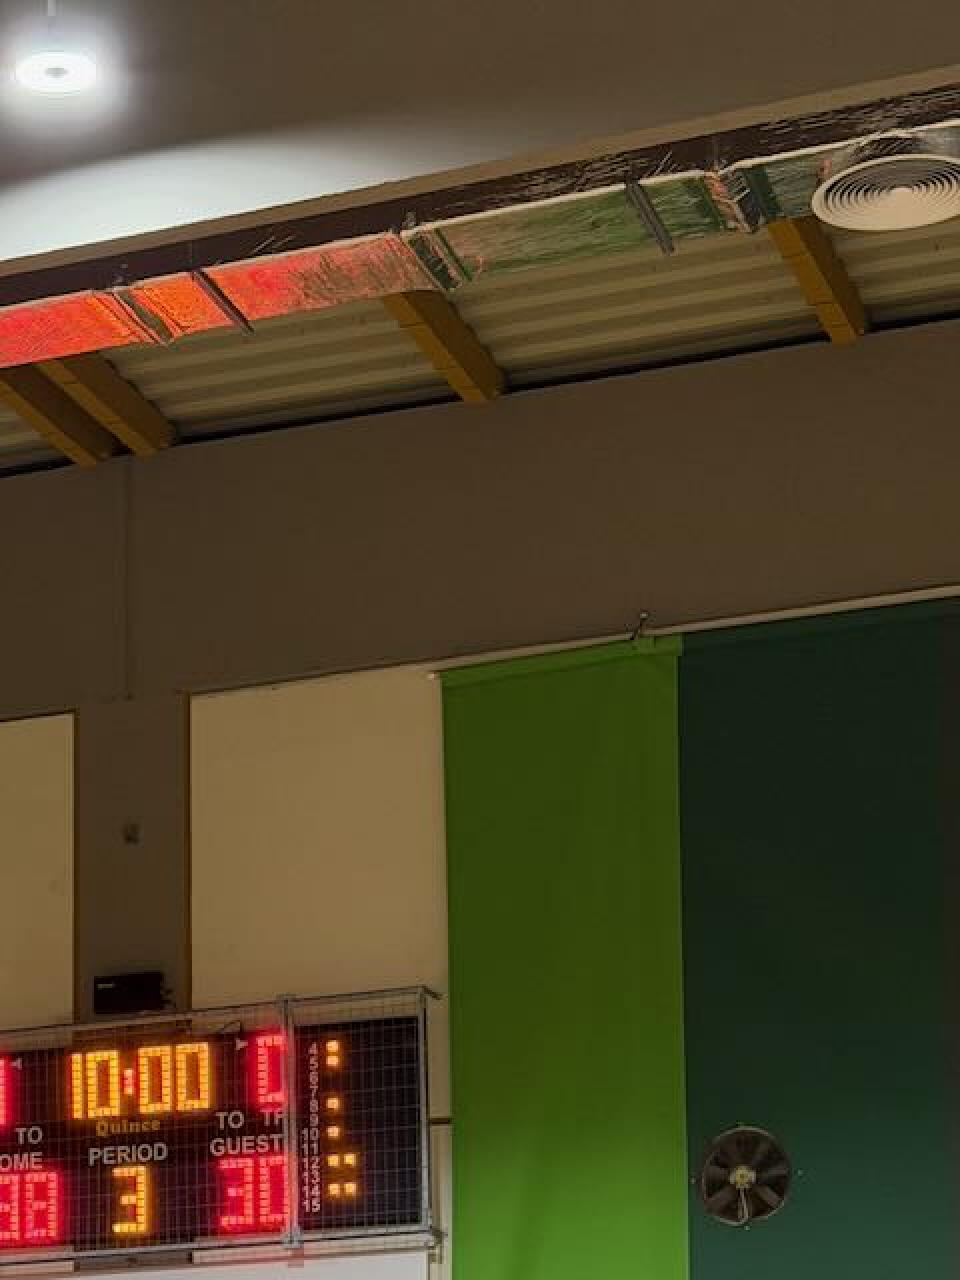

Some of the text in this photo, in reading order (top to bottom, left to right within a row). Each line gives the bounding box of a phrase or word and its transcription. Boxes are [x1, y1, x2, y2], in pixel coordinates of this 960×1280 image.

[71, 1042, 210, 1119] 10:00
[215, 1110, 245, 1130] TO
[15, 1126, 43, 1145] TO
[210, 1134, 284, 1157] GUEST
[87, 1142, 169, 1167] PERIOD
[112, 1166, 146, 1233] 3
[219, 1156, 289, 1226] 30
